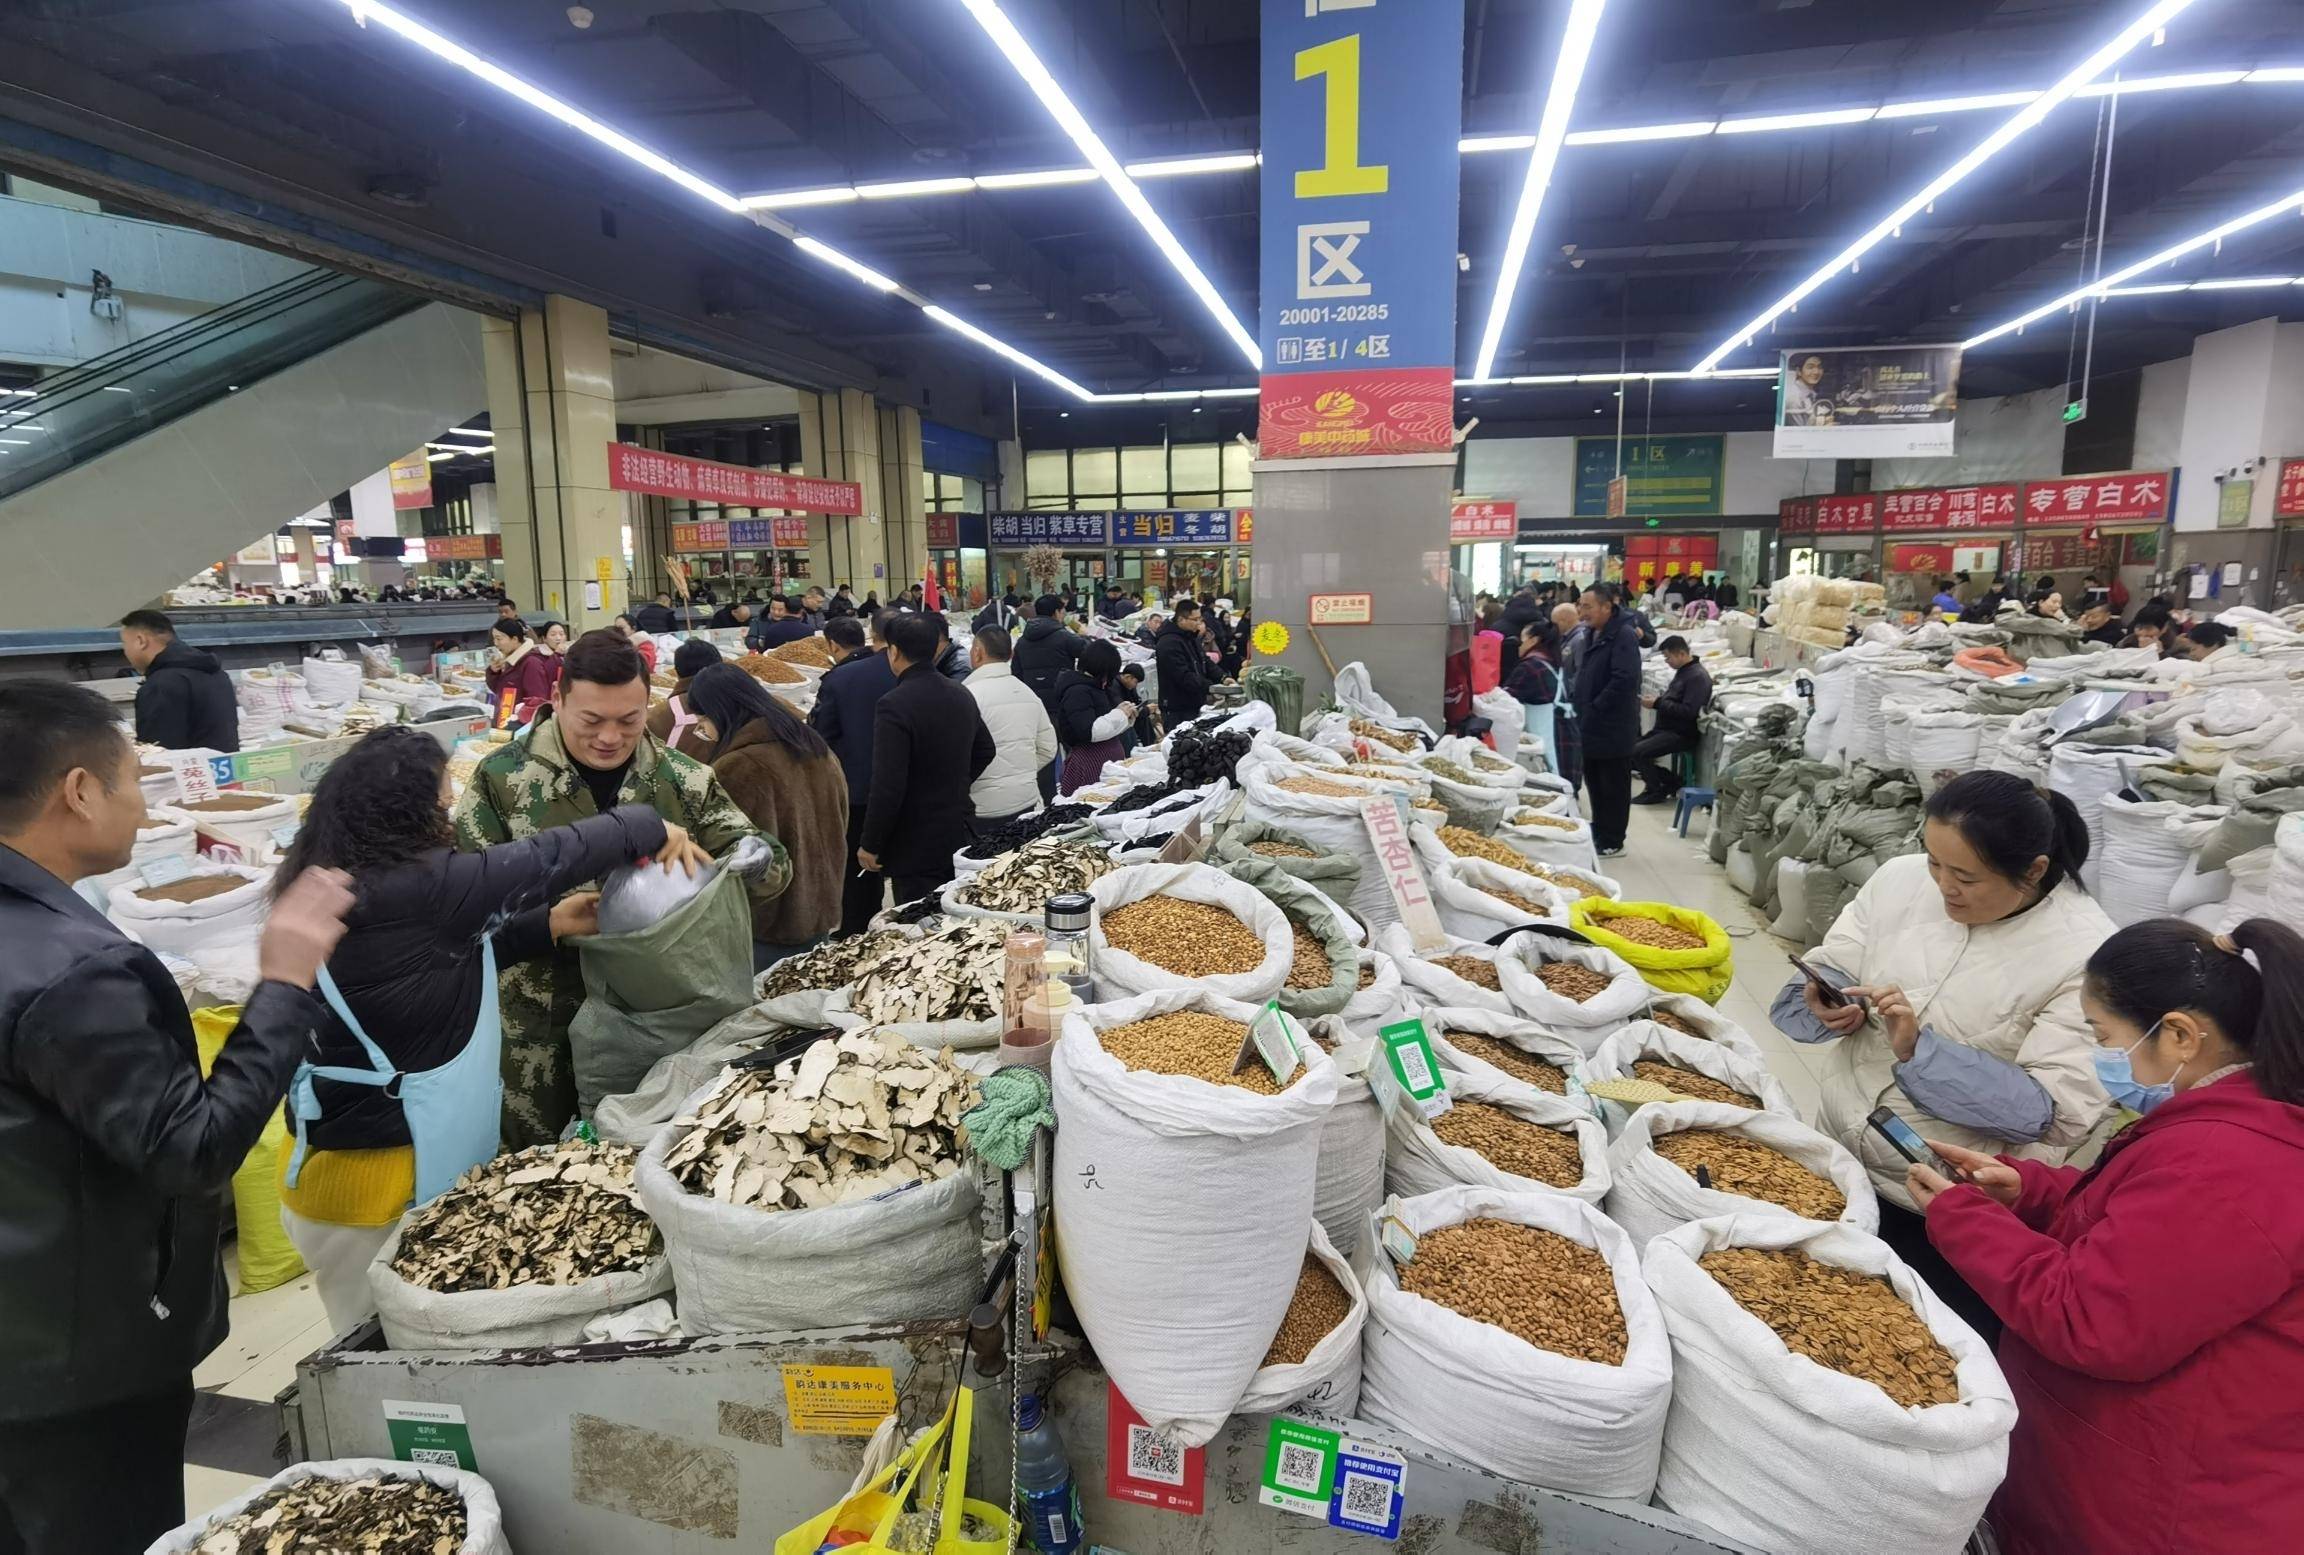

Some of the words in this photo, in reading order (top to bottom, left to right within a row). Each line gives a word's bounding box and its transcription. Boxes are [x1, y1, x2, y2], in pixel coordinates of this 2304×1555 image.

[1295, 33, 1388, 198] 1
[1297, 221, 1371, 299] 区
[1279, 304, 1389, 325] 20001-20285
[1884, 492, 1944, 513] 主营百合
[1982, 493, 2016, 514] 白术
[2029, 480, 2162, 513] 专营白术
[992, 515, 1018, 535] 柴胡
[1021, 516, 1046, 535] 当归
[1049, 514, 1103, 535] 紫草专营
[1133, 514, 1174, 536] 当归
[1183, 512, 1200, 535] 麦冬
[1209, 512, 1227, 535] 柴胡
[1366, 802, 1427, 907] 苦杏仁
[795, 1379, 885, 1392] 韵达康美服务中心
[1344, 1458, 1400, 1478] 推荐使用支付宝
[1285, 1497, 1316, 1512] 微信支付
